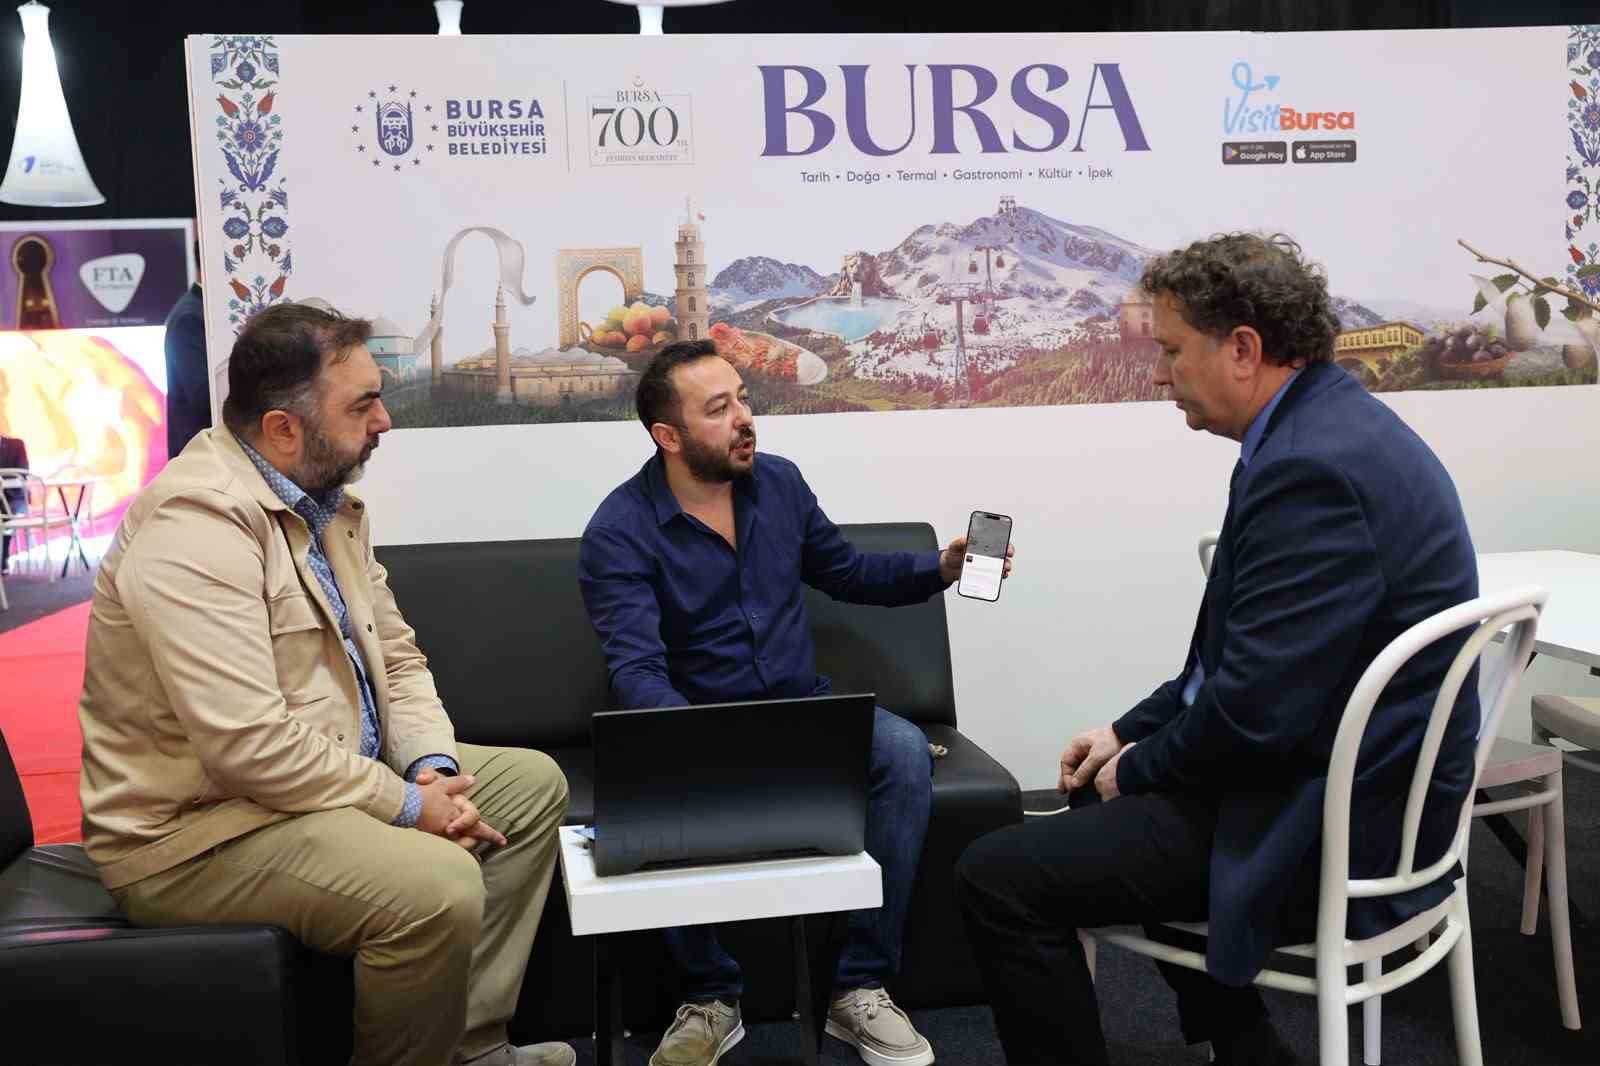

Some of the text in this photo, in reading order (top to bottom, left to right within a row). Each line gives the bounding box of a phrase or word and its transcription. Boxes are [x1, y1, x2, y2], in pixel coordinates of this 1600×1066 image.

[616, 90, 662, 103] BURSA
[446, 99, 544, 119] BURSA
[757, 63, 1152, 157] BURSA
[592, 105, 679, 147] 700
[448, 138, 547, 155] BELEDİYESİ
[1240, 151, 1284, 162] Google Play
[800, 165, 1113, 185] Tarih Doğa Termal Gastronomi Kültür İpek
[93, 266, 134, 282] FTA
